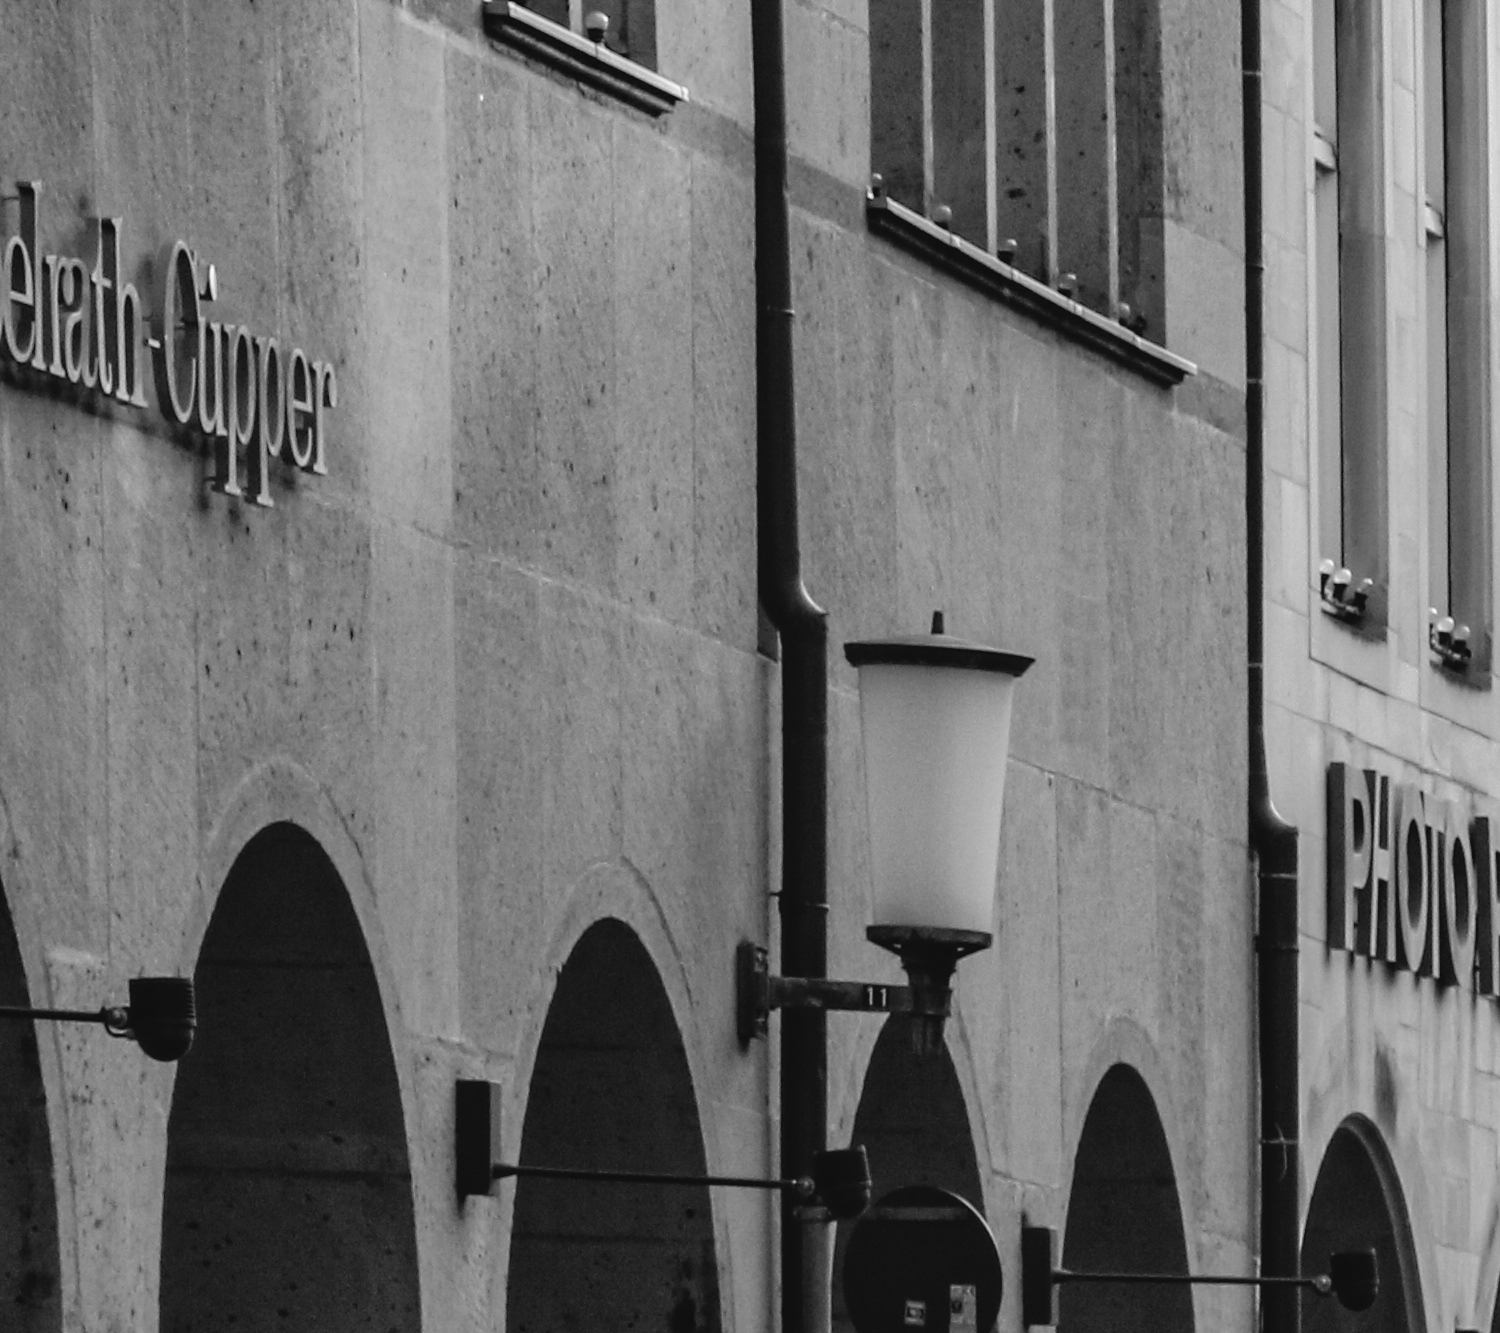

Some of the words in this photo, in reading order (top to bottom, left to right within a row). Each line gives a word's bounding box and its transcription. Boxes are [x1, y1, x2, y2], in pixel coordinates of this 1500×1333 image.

[0, 180, 337, 507] elrath-Cüpper
[1328, 762, 1478, 988] PHOTO
[867, 986, 887, 1008] 11
